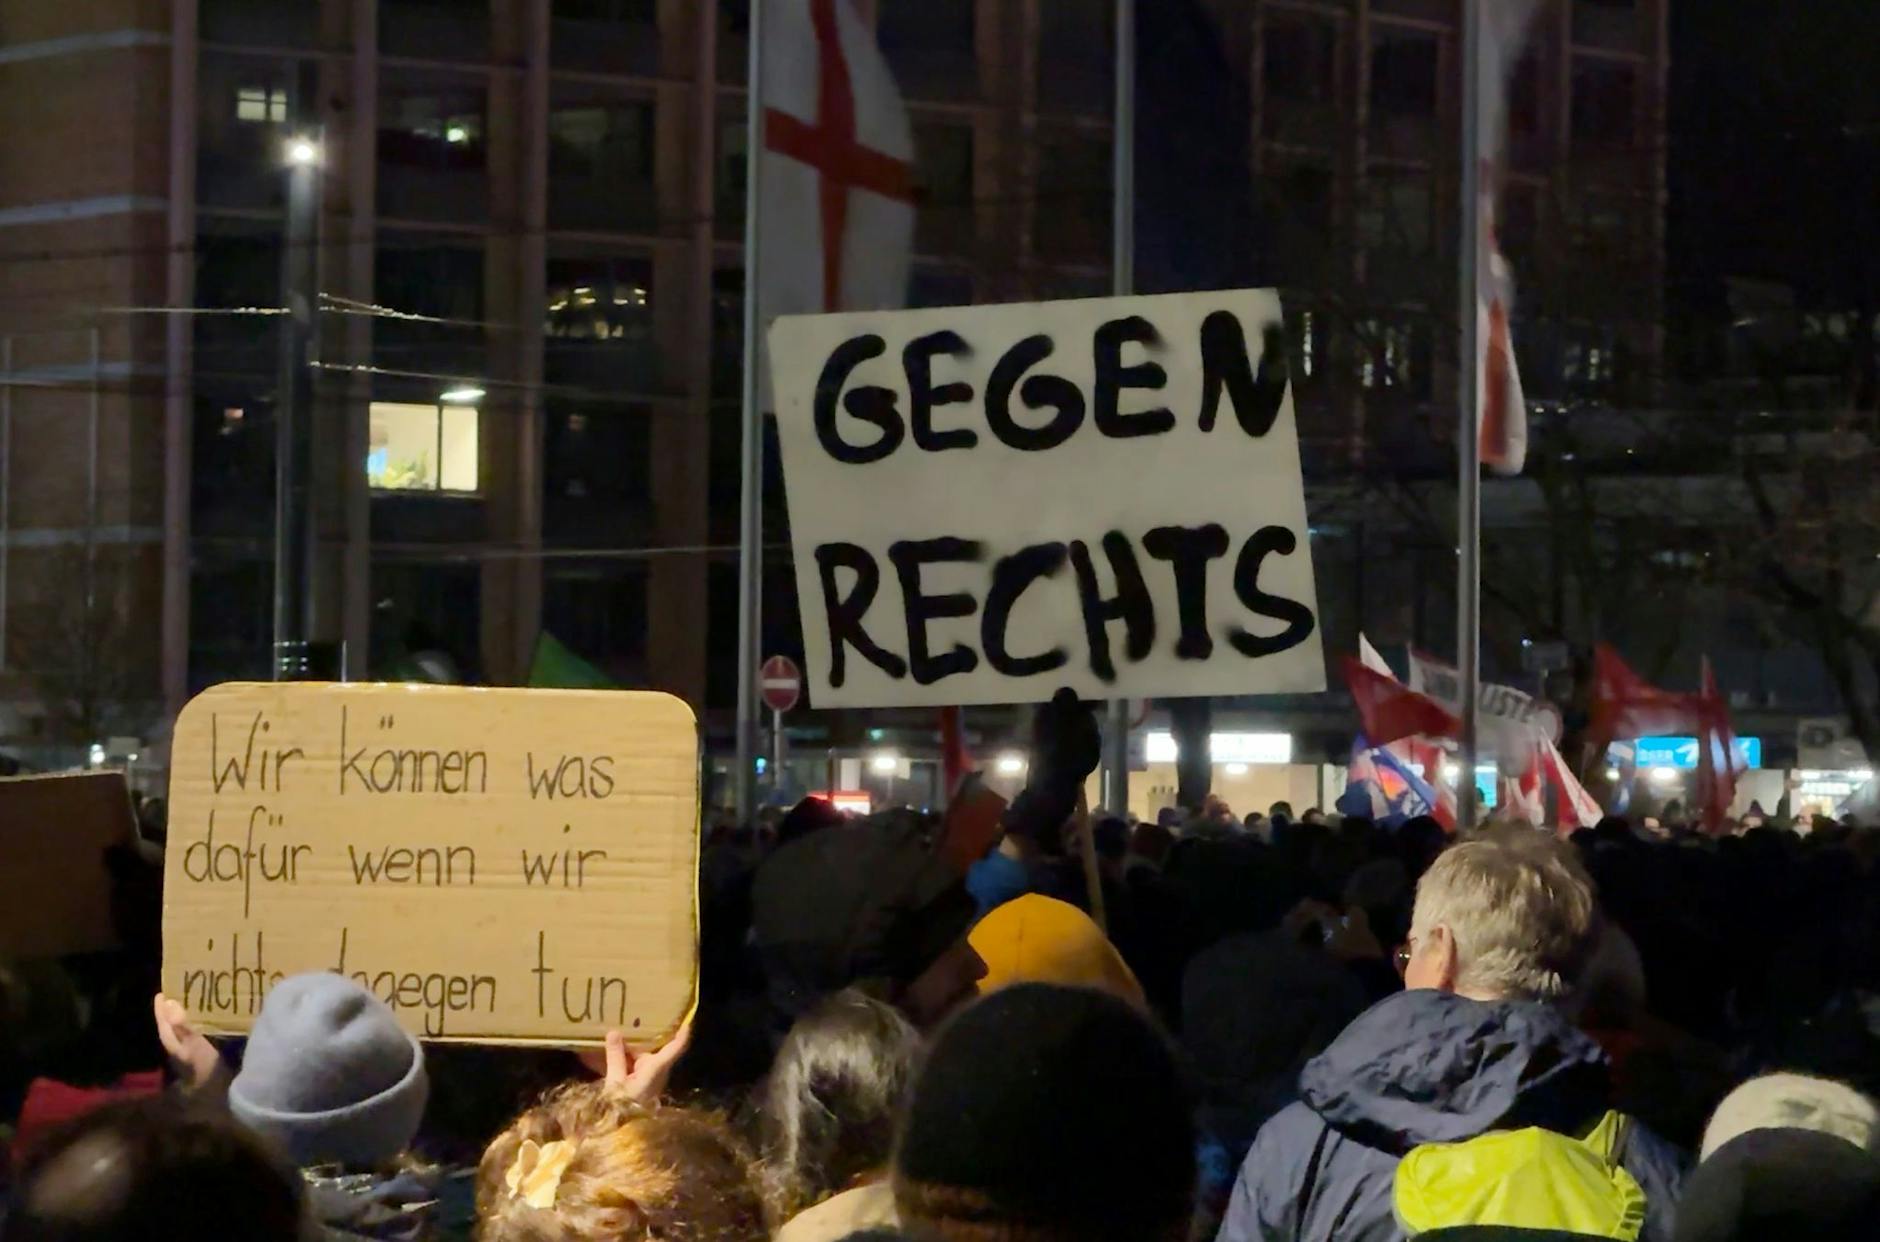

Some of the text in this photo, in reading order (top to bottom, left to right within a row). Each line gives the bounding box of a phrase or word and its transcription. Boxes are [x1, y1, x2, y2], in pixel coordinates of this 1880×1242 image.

[813, 310, 1292, 464] GEGEN
[815, 523, 1315, 687] RECHTS
[212, 704, 615, 800] Wir können was
[183, 806, 608, 919] dafür wenn wir
[531, 930, 641, 1029] tun.
